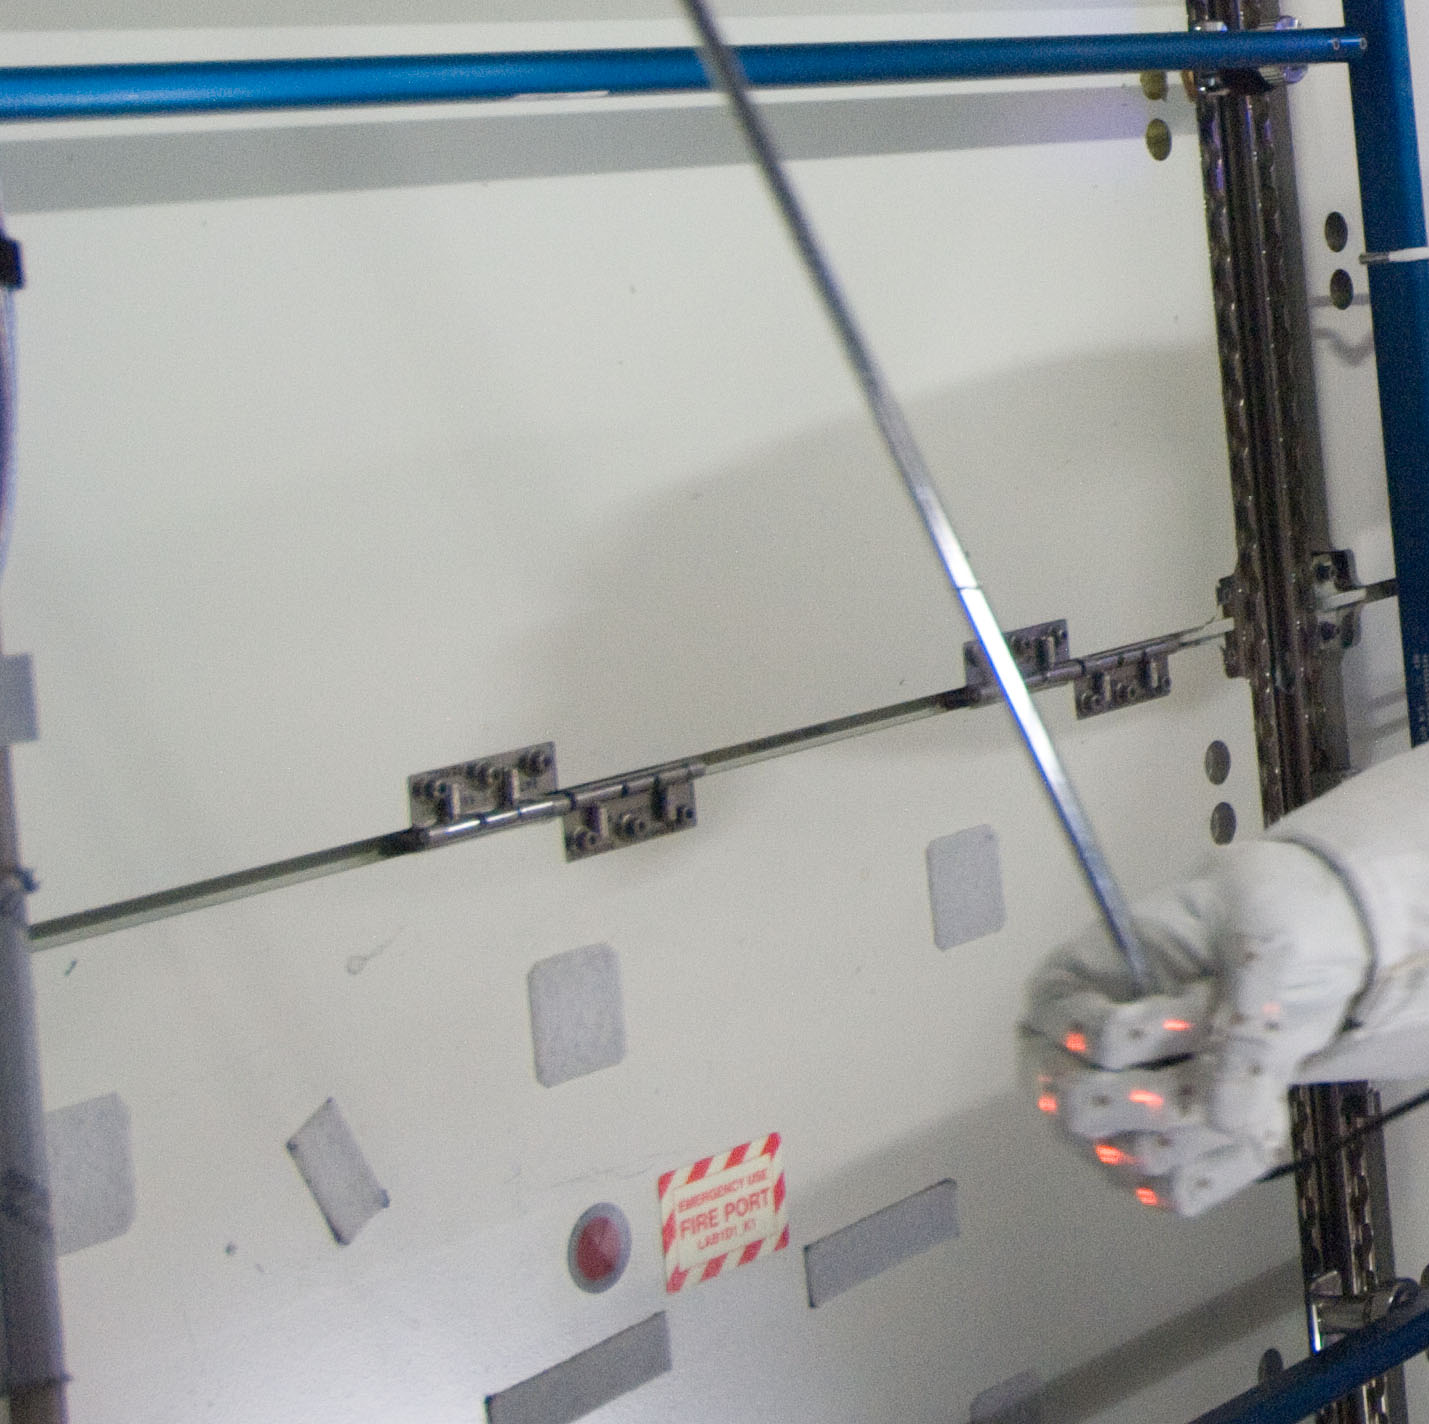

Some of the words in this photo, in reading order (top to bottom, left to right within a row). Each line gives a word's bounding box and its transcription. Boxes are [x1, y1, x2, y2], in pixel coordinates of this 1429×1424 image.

[678, 1177, 745, 1213] EMERGENCY
[747, 1167, 768, 1185] USE
[679, 1207, 719, 1241] FIRE
[724, 1187, 771, 1223] PORT
